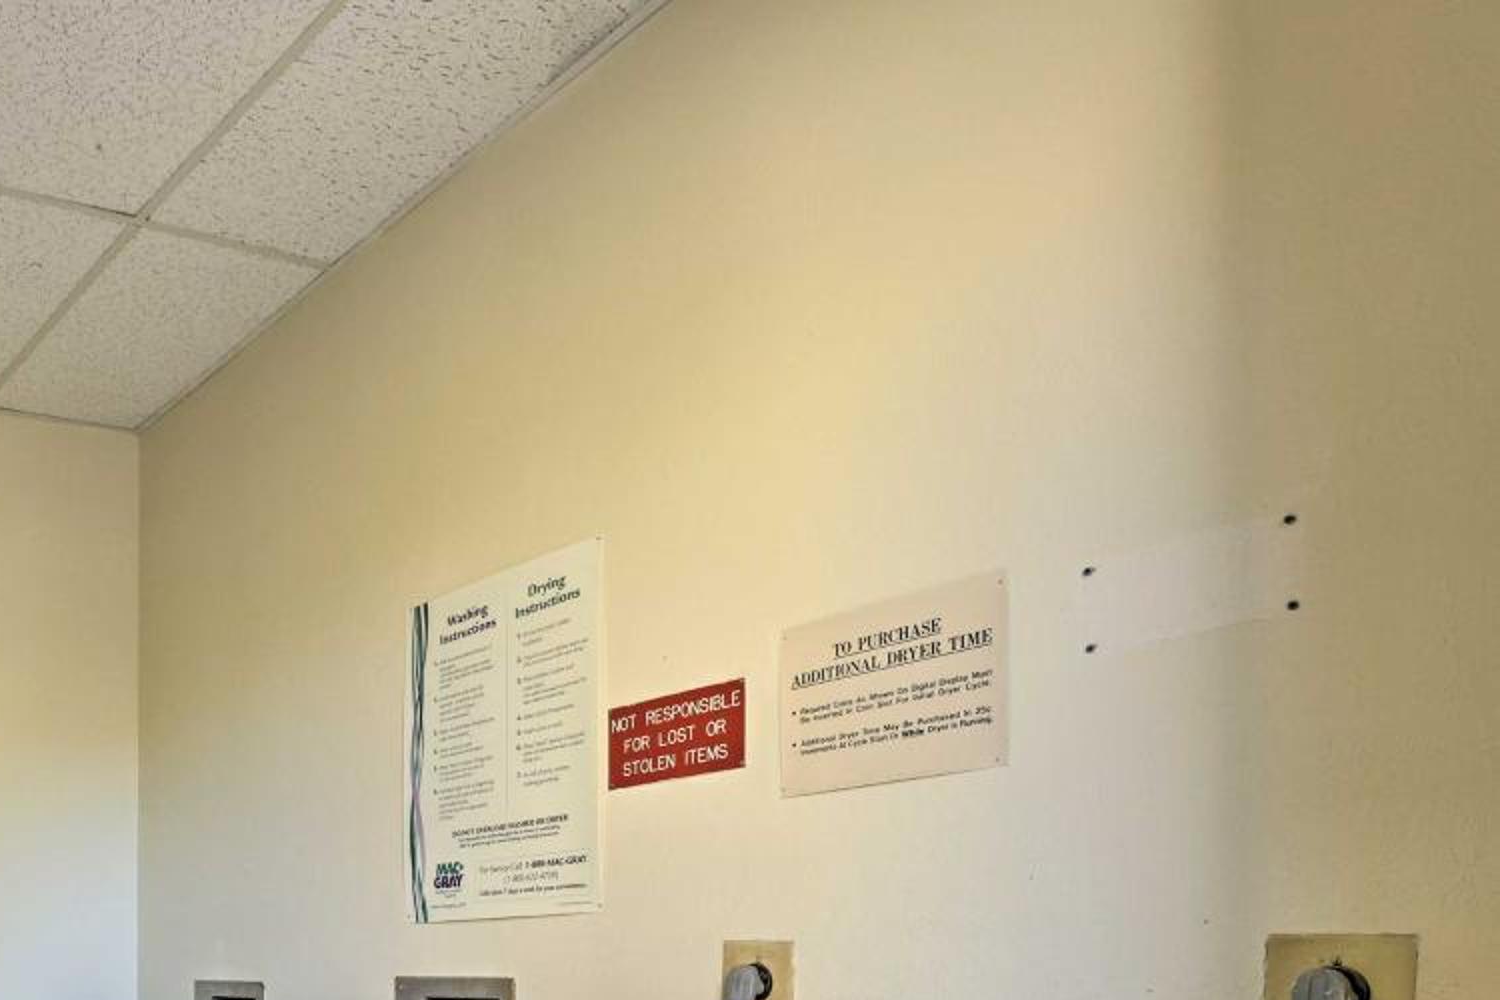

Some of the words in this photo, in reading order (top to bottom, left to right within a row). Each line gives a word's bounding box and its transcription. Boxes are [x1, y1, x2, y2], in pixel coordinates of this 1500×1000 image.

[527, 575, 566, 597] Drying
[447, 605, 489, 627] Washing
[515, 588, 580, 619] Instructions
[439, 619, 497, 645] Instructions
[832, 641, 853, 659] TO
[857, 617, 942, 650] PURCHASE
[791, 655, 880, 689] ADDITIONAL
[886, 641, 941, 666] DRYER
[949, 627, 994, 651] TIME
[611, 713, 637, 734] NOT
[645, 689, 741, 726] RESPONSIBLE
[623, 735, 650, 754] FOR
[658, 725, 695, 747] LOST
[705, 718, 727, 737] OR
[623, 754, 676, 777] STOLEN
[685, 743, 729, 765] ITEMS
[433, 873, 465, 889] GRAY
